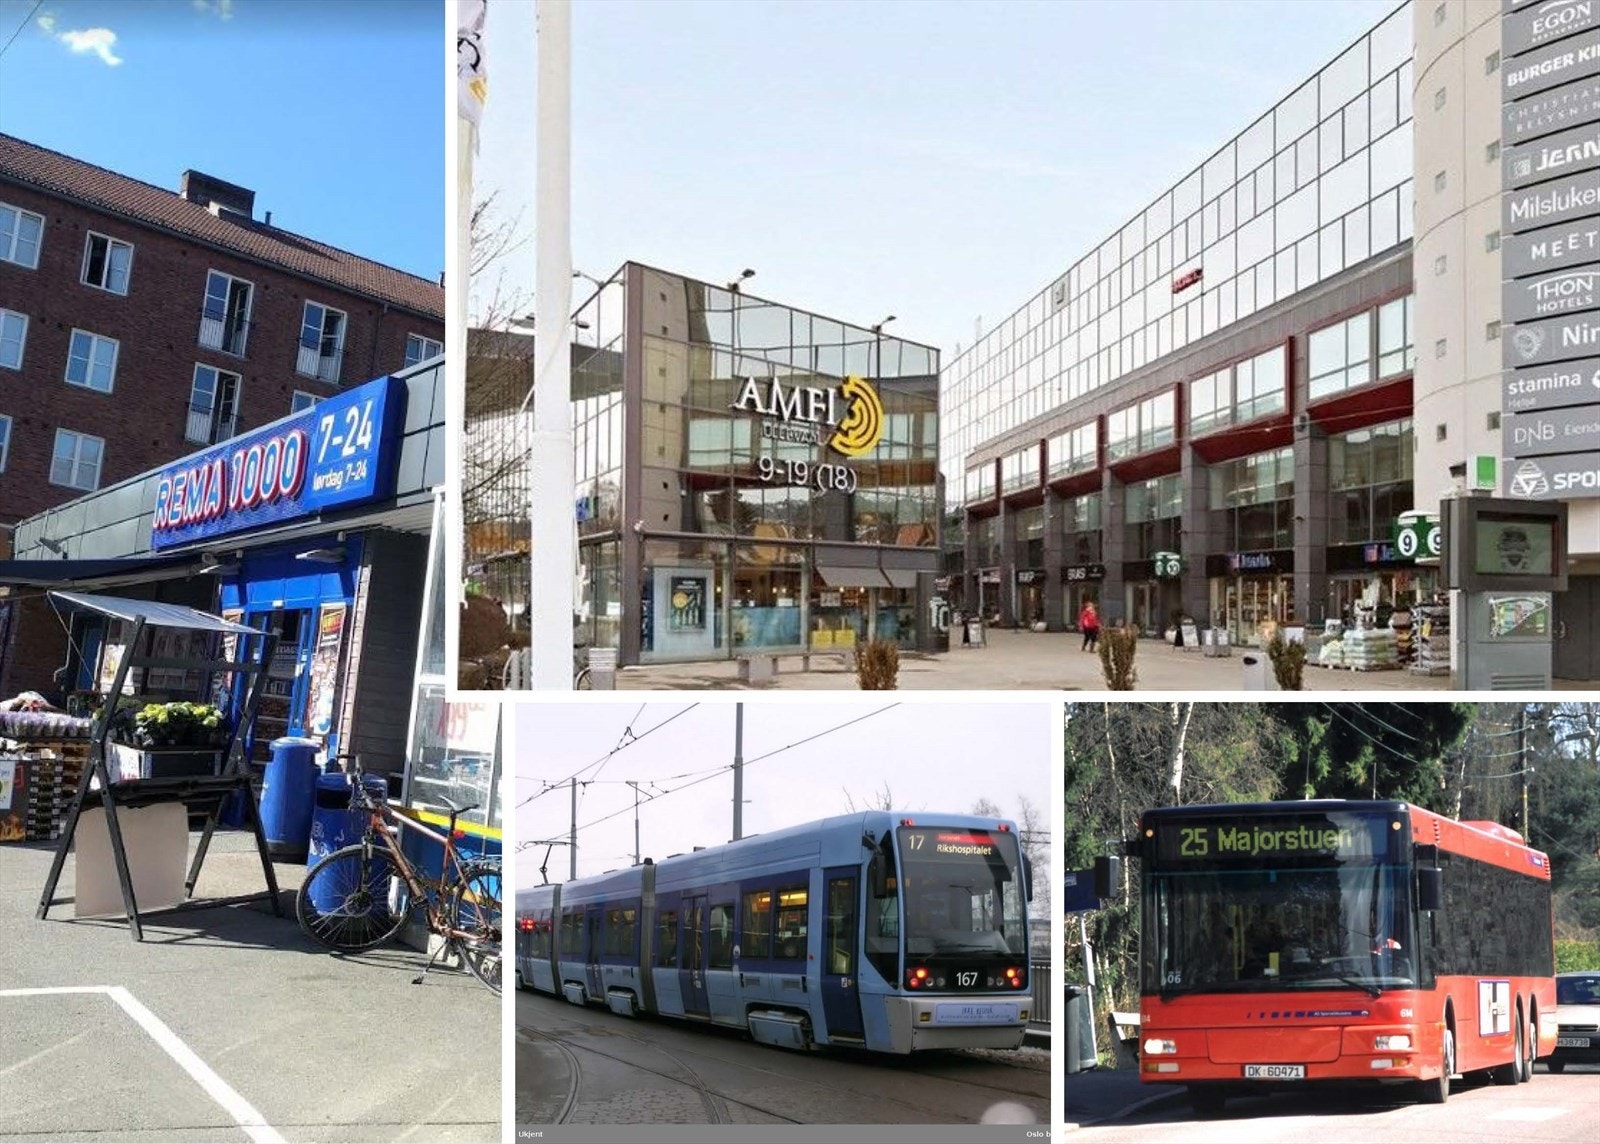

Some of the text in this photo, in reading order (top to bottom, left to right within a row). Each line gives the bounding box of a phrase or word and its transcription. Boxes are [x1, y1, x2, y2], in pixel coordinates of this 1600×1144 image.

[1532, 2, 1591, 34] EGON
[1507, 44, 1600, 87] BURGER KI
[1531, 230, 1598, 260] MEET
[1530, 272, 1598, 300] THON
[1536, 294, 1593, 313] HOTELS
[1508, 373, 1582, 395] stamina
[728, 376, 836, 426] AMFI
[318, 400, 373, 463] 7-24
[1514, 420, 1555, 447] DNB
[153, 429, 309, 531] REMA 1000
[759, 456, 857, 496] 9-19 (18)
[1403, 534, 1413, 553] 9
[908, 834, 925, 850] 17
[936, 843, 992, 856] Rikshospitalet
[1180, 825, 1352, 856] 25 Majorstuen
[956, 972, 978, 987] 167
[1247, 1066, 1301, 1077] DK 60471
